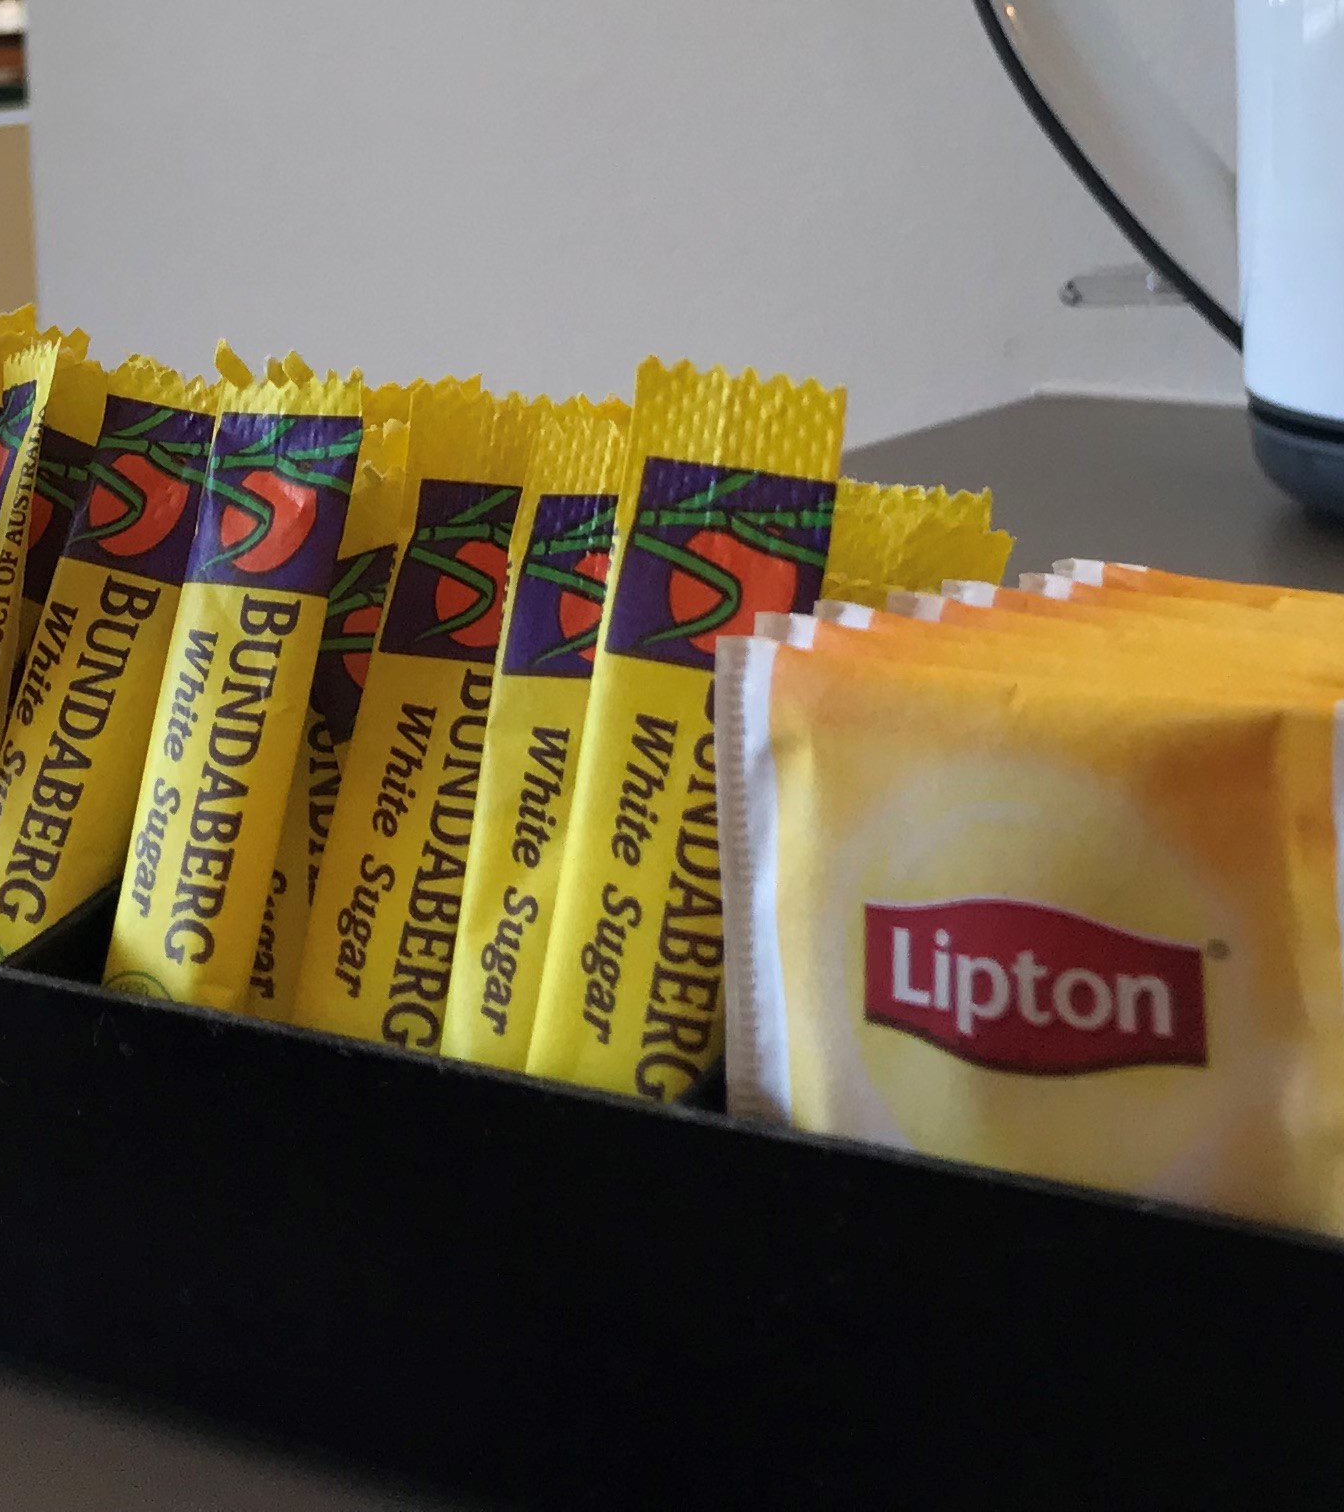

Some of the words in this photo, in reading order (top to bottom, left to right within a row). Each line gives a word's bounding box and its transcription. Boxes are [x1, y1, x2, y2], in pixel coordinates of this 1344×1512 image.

[16, 599, 79, 727] White
[163, 628, 220, 763] White
[165, 593, 302, 966] BUNDABERG
[372, 701, 438, 838] White
[511, 725, 571, 869] White
[610, 710, 680, 868] White
[131, 776, 181, 919] Sugar
[380, 668, 495, 1050] BUNDABERG
[334, 852, 396, 999] Sugar
[480, 884, 539, 1037] Sugar
[580, 882, 643, 1046] Sugar
[890, 926, 1174, 1037] Lipton
